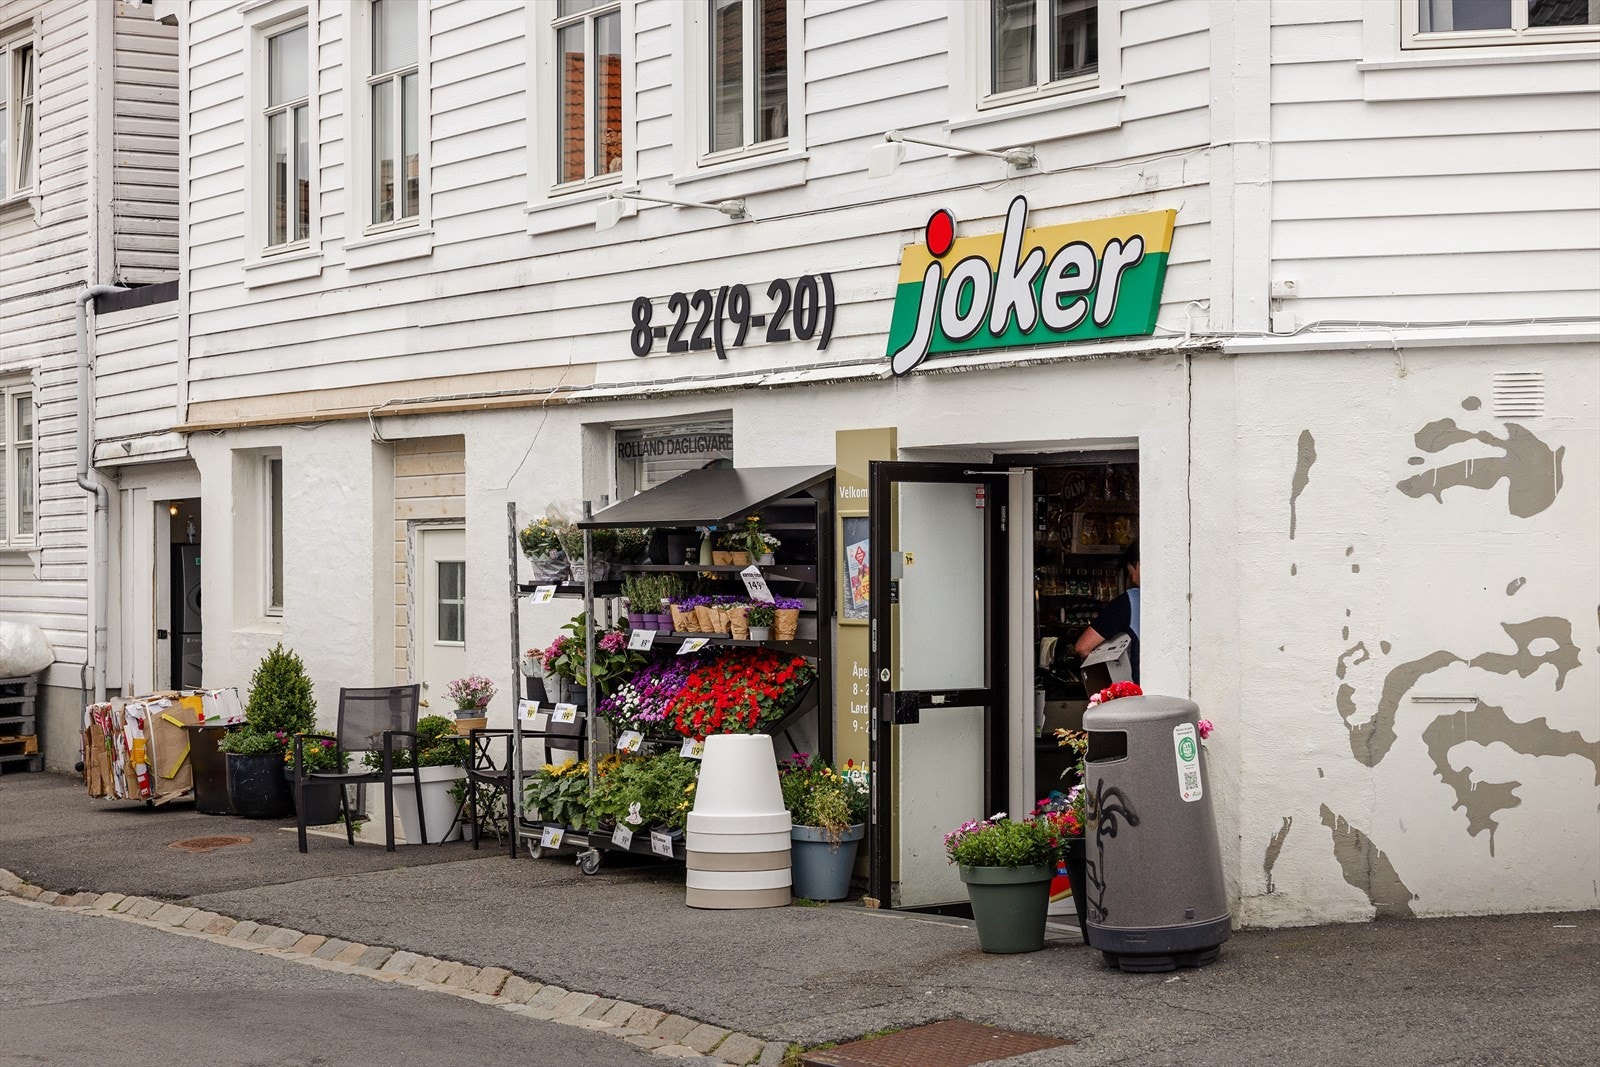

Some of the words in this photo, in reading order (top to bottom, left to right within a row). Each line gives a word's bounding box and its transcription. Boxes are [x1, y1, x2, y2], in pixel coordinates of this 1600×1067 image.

[891, 194, 1145, 378] joker
[630, 272, 835, 360] 8-22(9-20)
[618, 440, 664, 459] ROLLAND
[666, 435, 733, 456] DAGLIGVARE
[852, 660, 869, 680] Åpe
[852, 682, 859, 696] 8
[852, 719, 859, 733] 9
